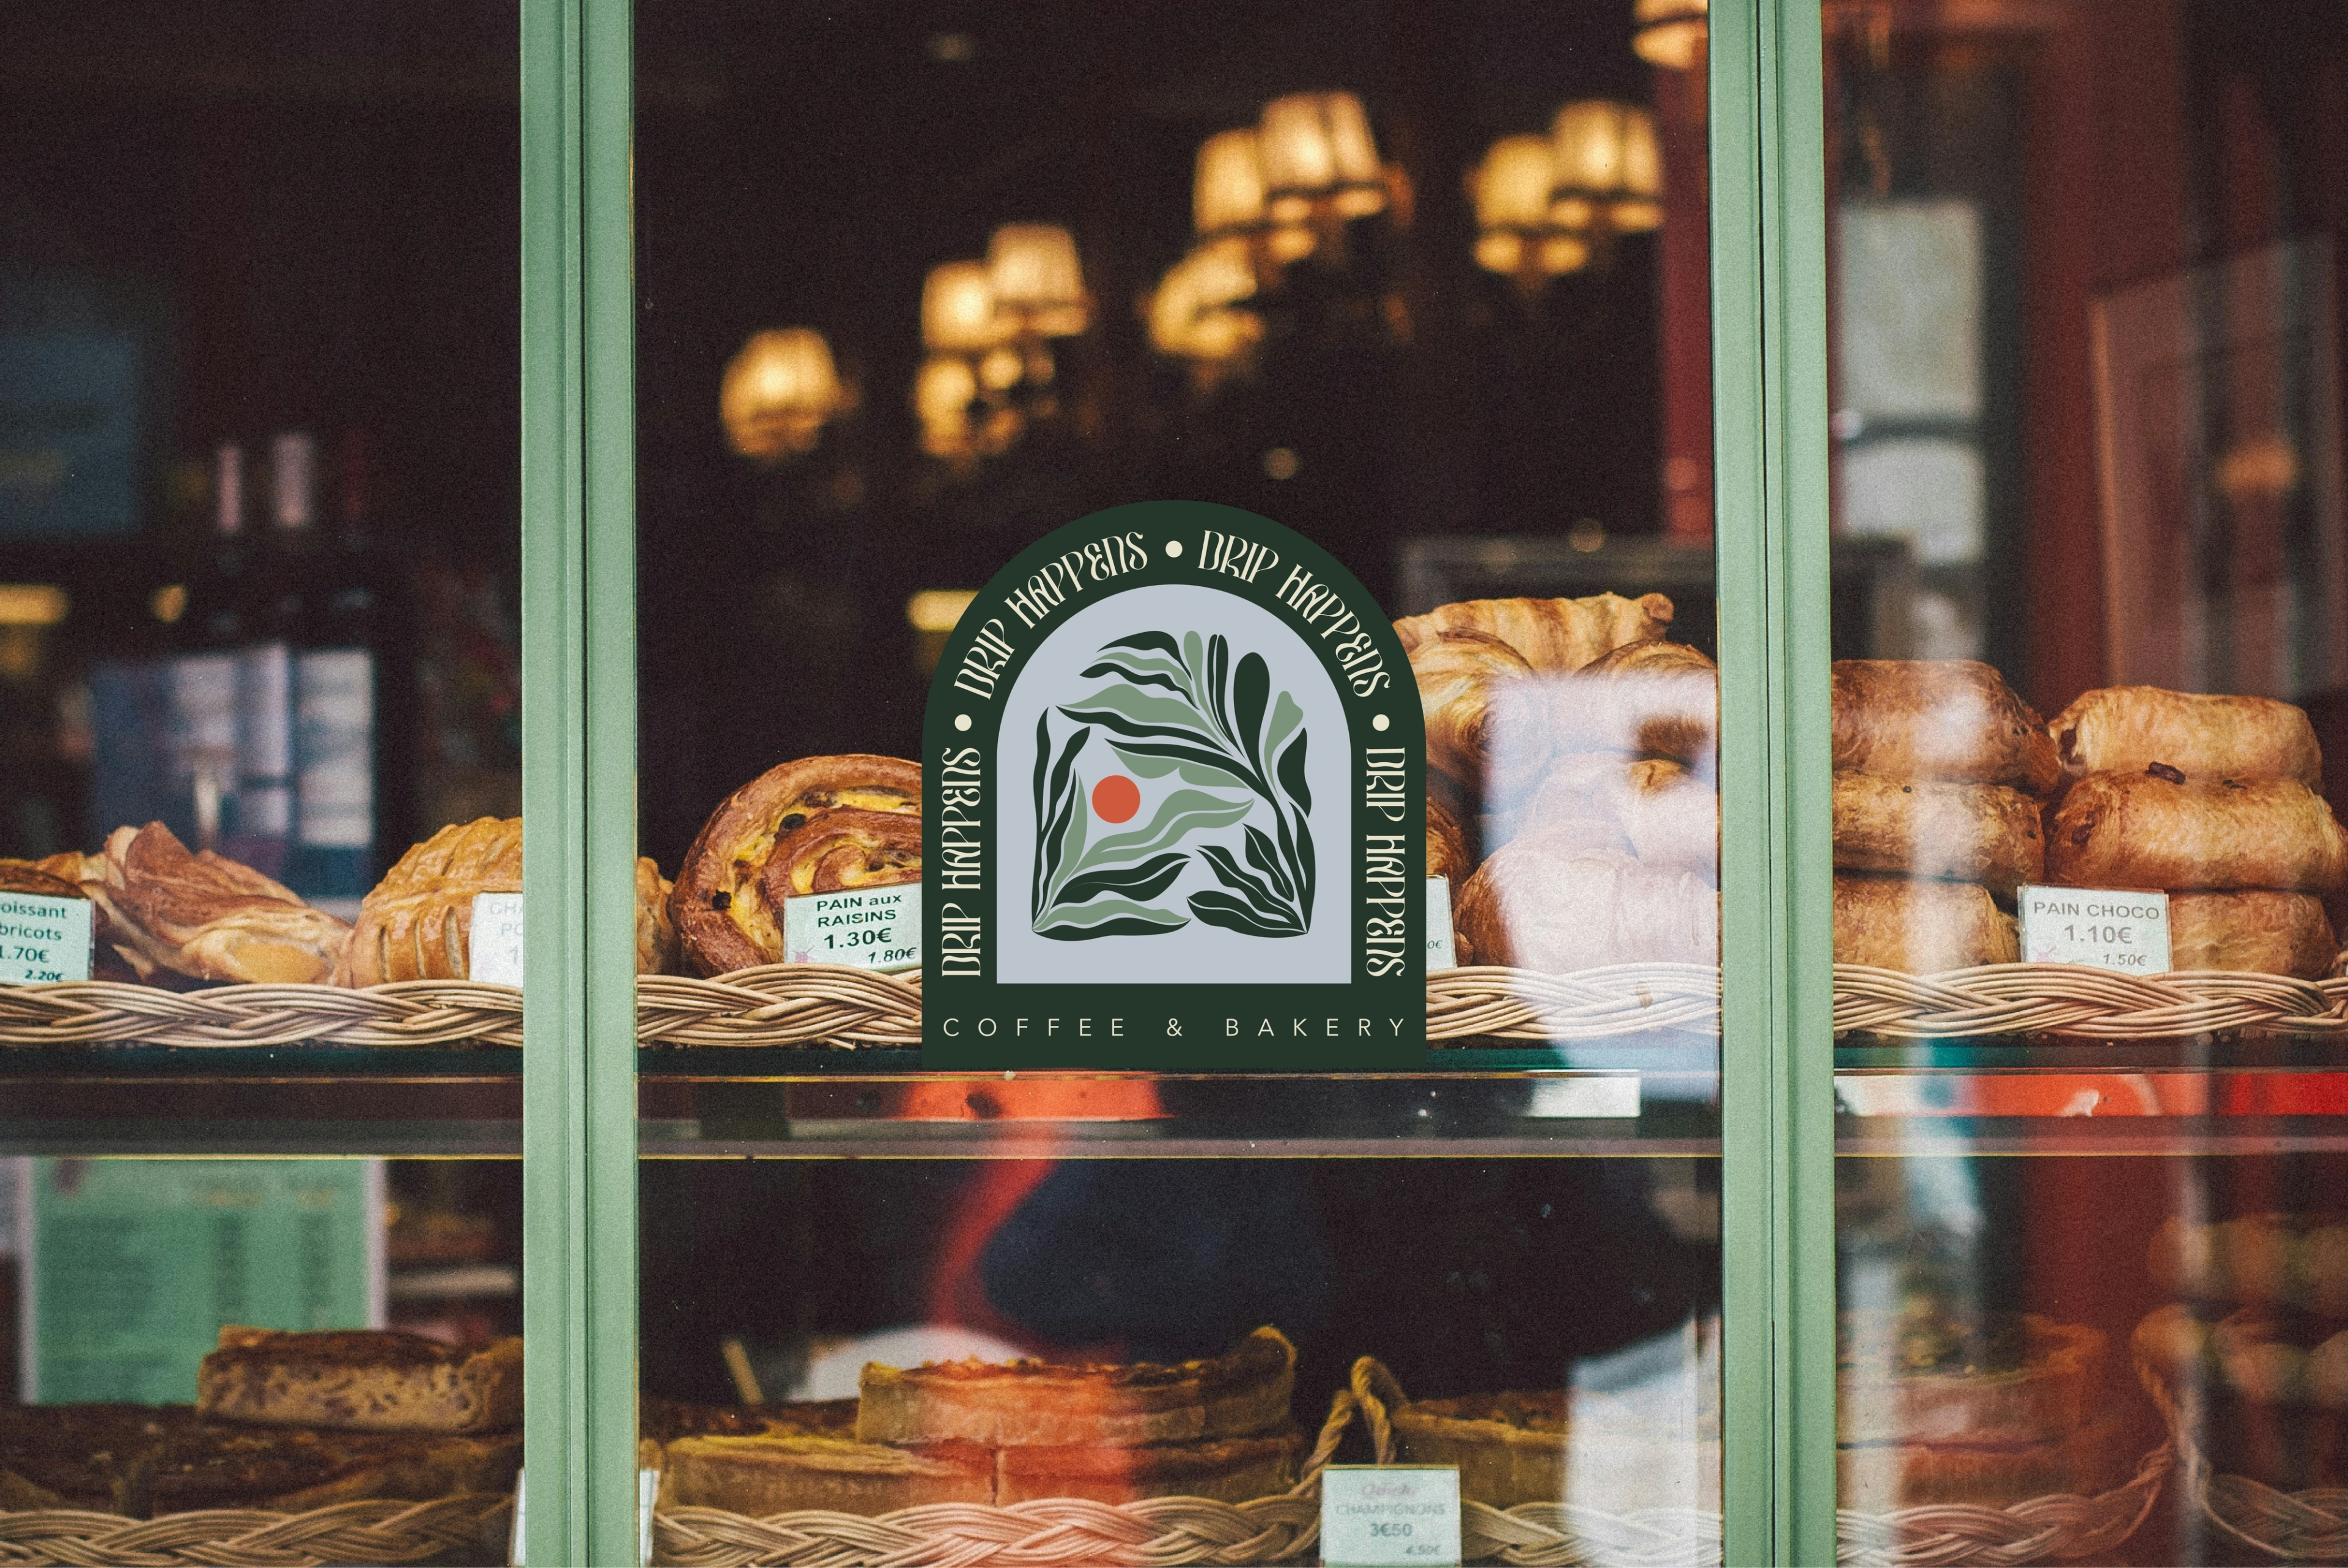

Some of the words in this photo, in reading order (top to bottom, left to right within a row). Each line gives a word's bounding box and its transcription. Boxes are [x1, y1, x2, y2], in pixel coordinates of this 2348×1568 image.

[954, 618, 1015, 701] DRIP
[1004, 530, 1148, 630] HAPPENS
[1197, 529, 1280, 584] DRIP
[1275, 563, 1391, 699] HAPPENS
[1366, 747, 1405, 822] DRIP
[942, 747, 981, 891] HAPPENS
[817, 897, 863, 911] PAIN
[869, 894, 902, 906] aux
[1366, 834, 1405, 977] HAPPENS
[2034, 902, 2079, 916] PAIN
[2087, 904, 2160, 919] CHOCO
[818, 910, 897, 927] RAISINS
[824, 927, 892, 949] 1.30€
[942, 902, 981, 977] DRIP
[2064, 924, 2133, 944] 1.10€
[868, 947, 917, 964] 1.80€
[2103, 954, 2148, 966] 1.50€
[24, 969, 64, 982] 2.20€
[943, 1018, 1124, 1037] COFFEE
[1166, 1018, 1183, 1037] &
[1226, 1018, 1405, 1037] BAKERY
[1335, 1503, 1446, 1515] CHAMPIGNONS
[1370, 1523, 1413, 1537] 3€50
